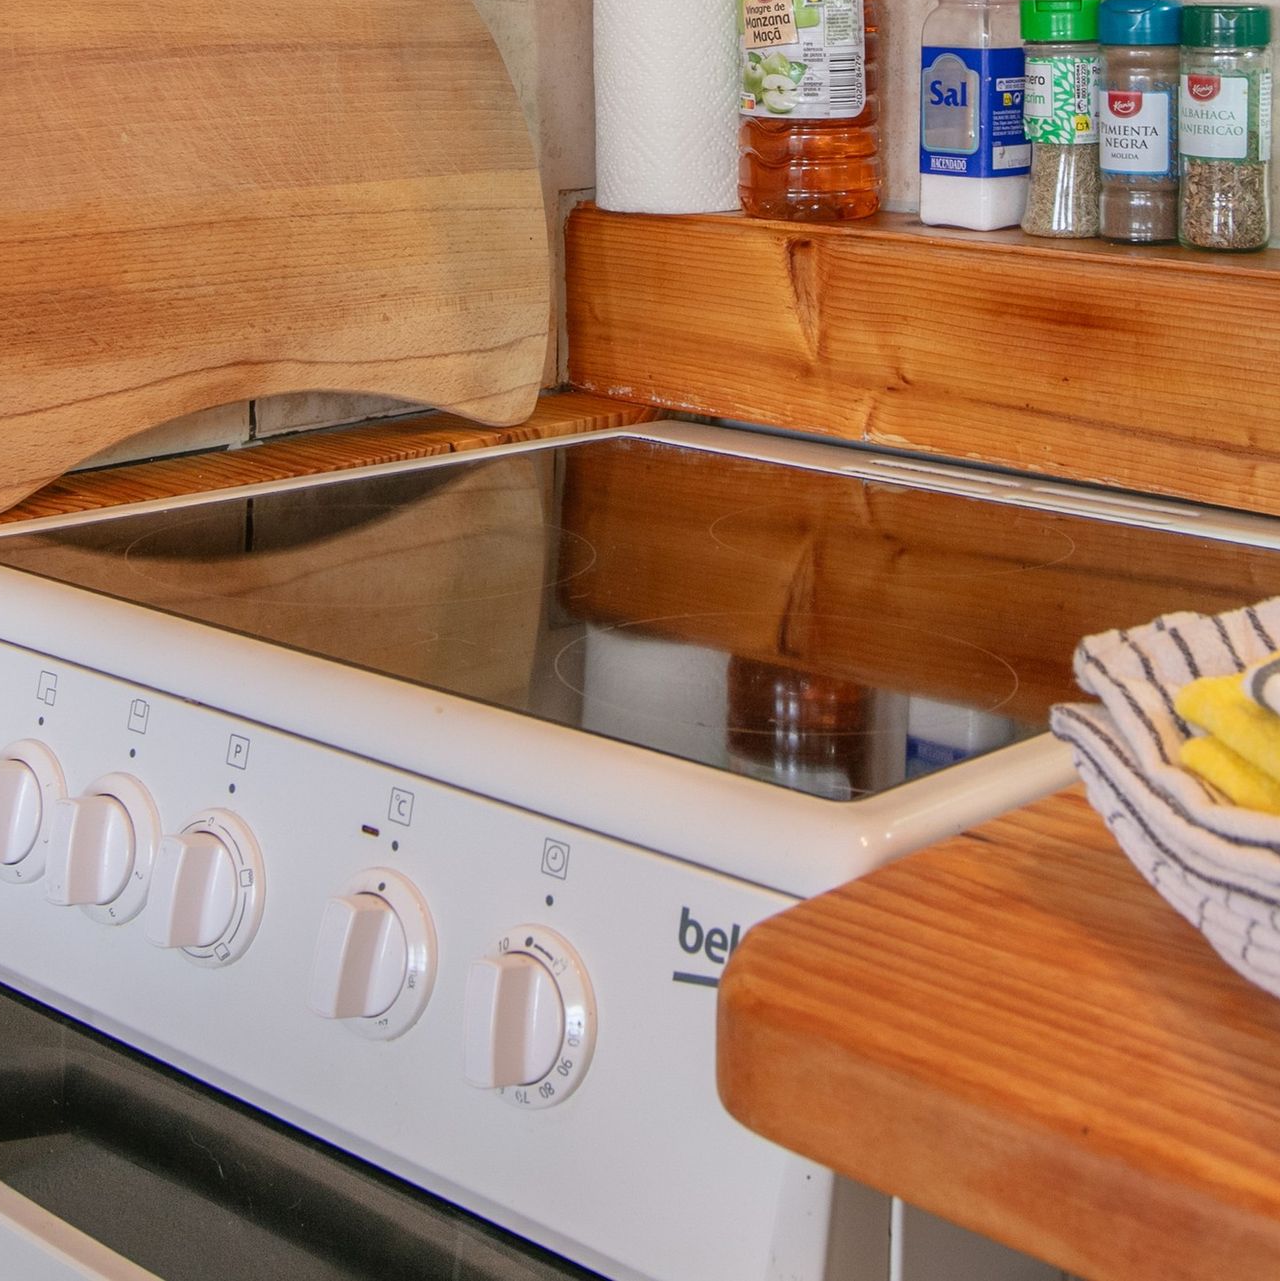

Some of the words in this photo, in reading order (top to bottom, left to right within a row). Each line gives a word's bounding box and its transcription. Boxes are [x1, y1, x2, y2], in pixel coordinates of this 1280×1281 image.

[746, 4, 772, 16] Vinagre
[774, 3, 786, 11] de
[745, 13, 791, 29] Manzana
[753, 27, 782, 44] Maçã
[930, 80, 968, 107] Sal
[1100, 122, 1159, 137] PIMIENTA
[1105, 138, 1149, 150] NEGRA
[1111, 152, 1139, 160] MOLIDA
[930, 157, 968, 171] HACENDADO
[233, 744, 242, 758] P
[498, 937, 510, 952] 10
[556, 1057, 573, 1077] 90
[538, 1082, 555, 1099] 80
